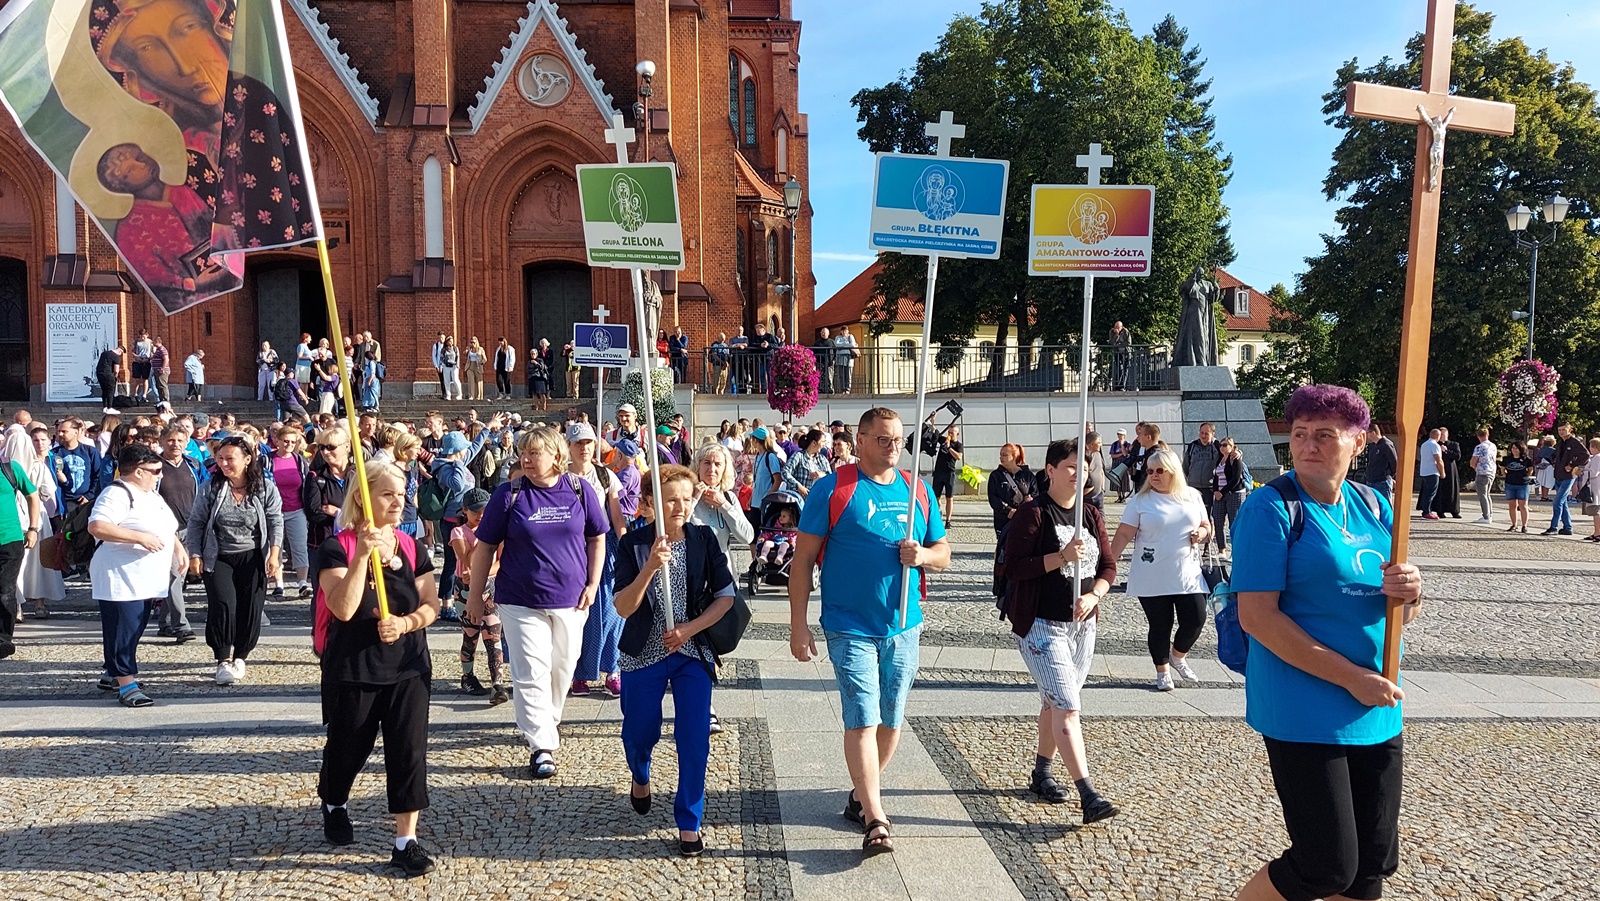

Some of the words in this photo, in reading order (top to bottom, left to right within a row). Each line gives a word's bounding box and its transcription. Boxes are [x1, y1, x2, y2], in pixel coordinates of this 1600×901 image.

[918, 224, 980, 236] BŁĘKITNA
[622, 236, 664, 247] ZIELONA
[1036, 248, 1144, 257] AMARANTOWO-ŻÓŁTA
[48, 313, 102, 322] KONCERTY
[48, 322, 101, 330] ORGANOWE
